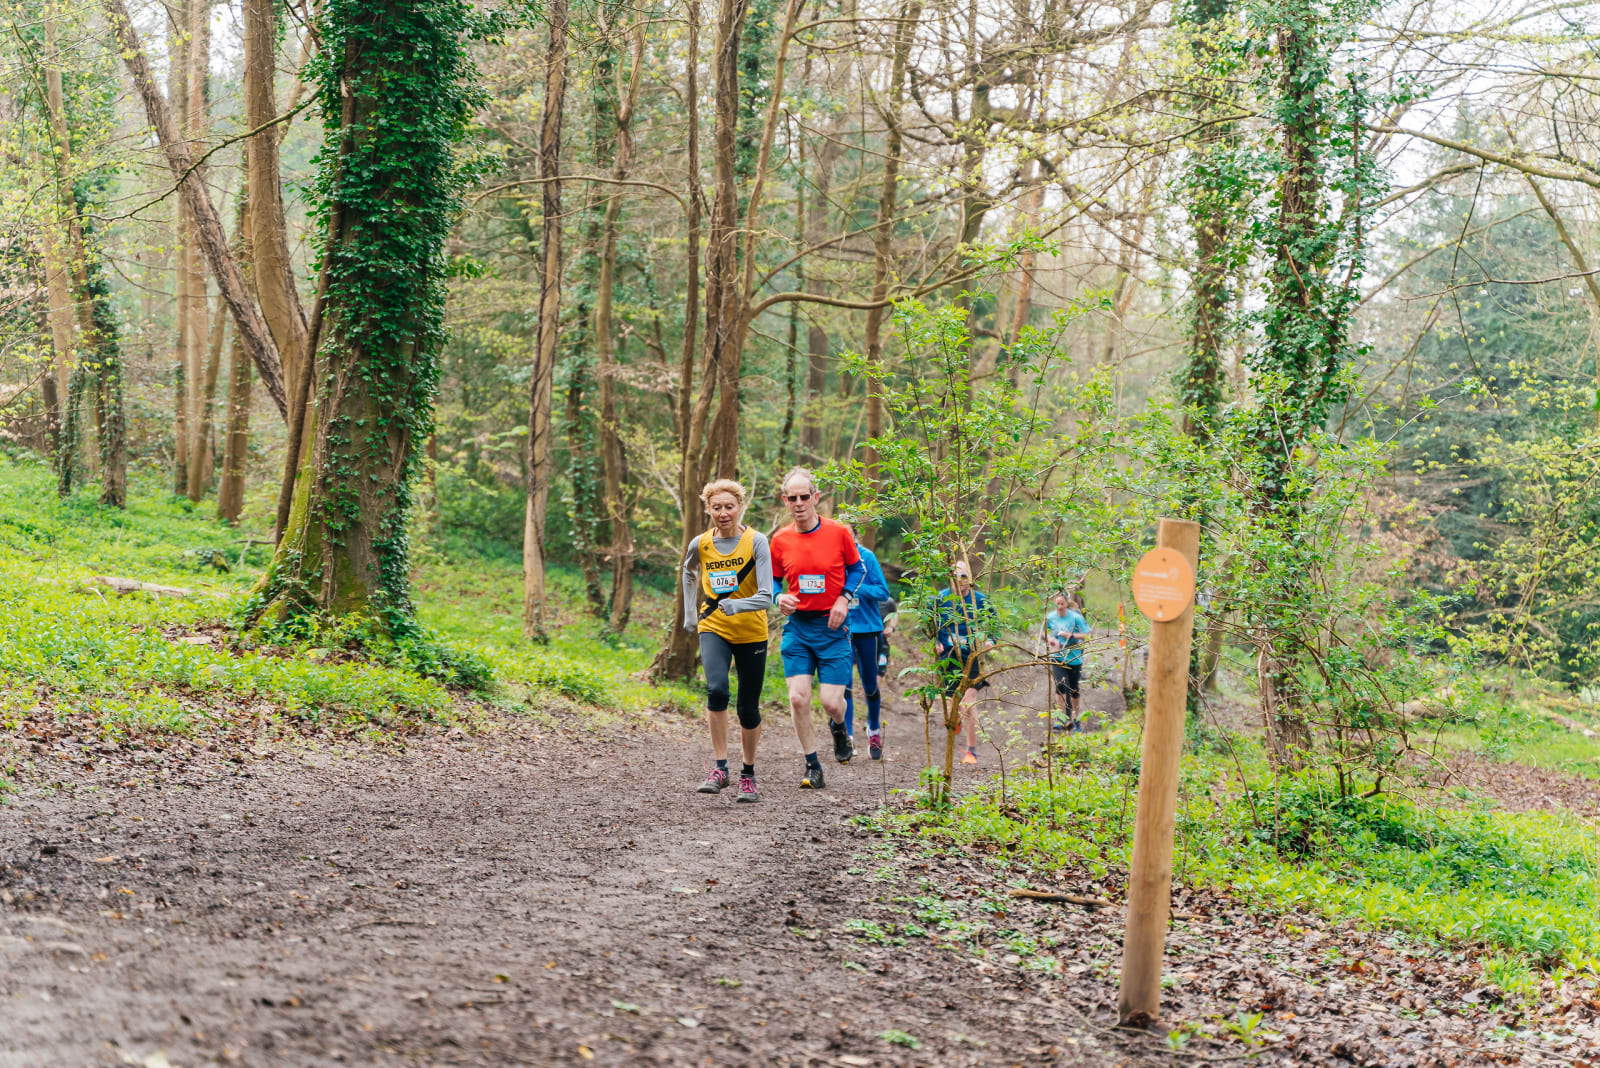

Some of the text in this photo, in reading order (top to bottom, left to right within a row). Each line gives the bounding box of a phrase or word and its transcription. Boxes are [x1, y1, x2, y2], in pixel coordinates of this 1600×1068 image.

[705, 557, 744, 570] BEDFORD
[716, 577, 729, 586] 076
[807, 580, 818, 588] 173
